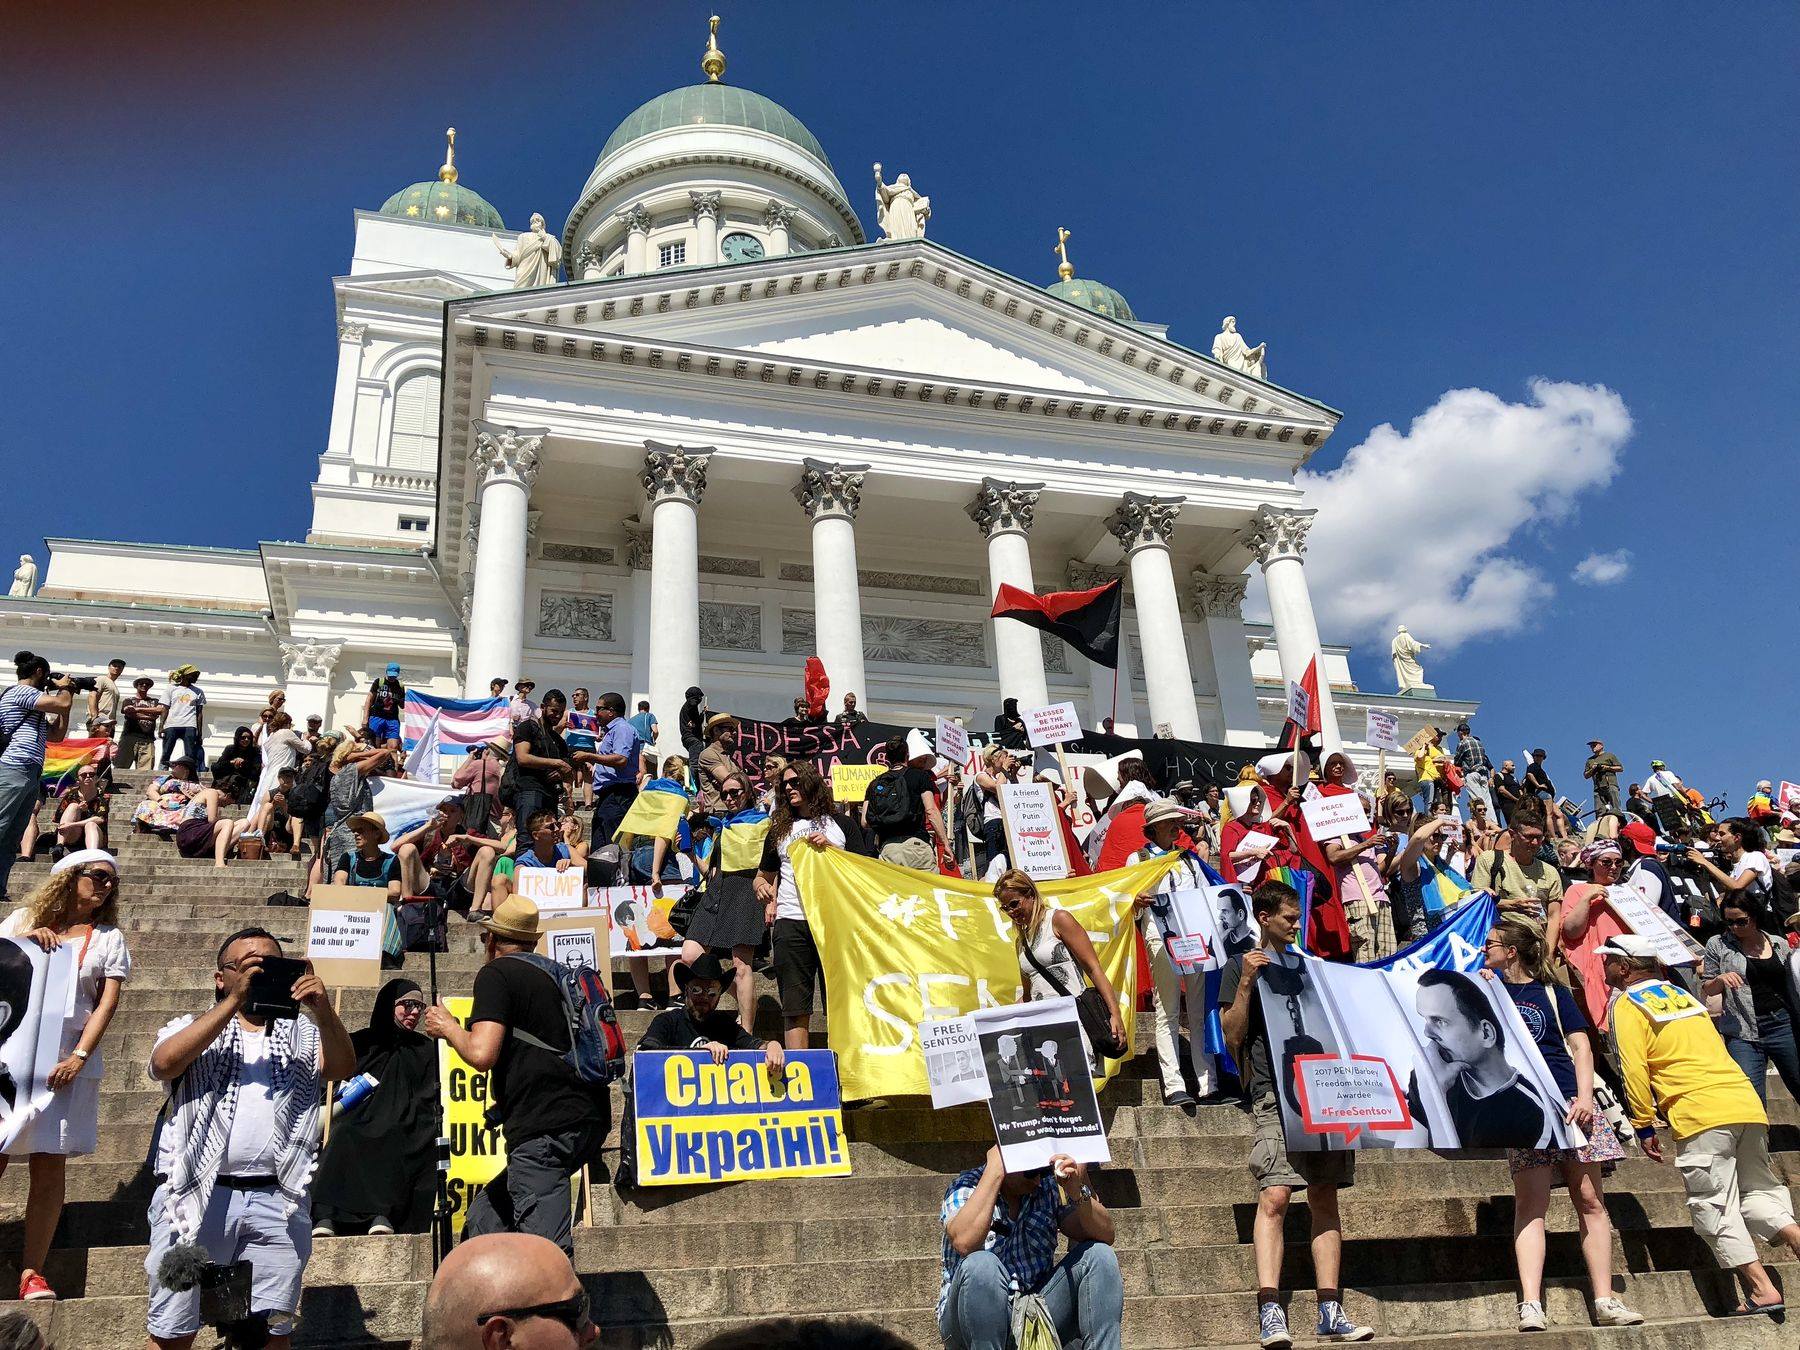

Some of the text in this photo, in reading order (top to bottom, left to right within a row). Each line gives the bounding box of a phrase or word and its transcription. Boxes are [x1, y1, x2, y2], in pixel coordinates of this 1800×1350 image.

[1034, 708, 1065, 719] BLESSED
[1039, 718, 1049, 726] BE
[943, 723, 961, 736] BLESSED
[1033, 722, 1073, 734] IMMIGRANT
[737, 722, 861, 754] HDESSÄ
[1045, 731, 1066, 739] CHILD
[946, 746, 960, 757] CHILD
[1019, 789, 1040, 797] friend
[1021, 802, 1044, 810] Trump
[1320, 802, 1345, 812] PEACE
[1022, 813, 1041, 821] Putin
[1315, 814, 1359, 828] DEMOCRACY
[1027, 850, 1052, 858] Europe
[1032, 864, 1062, 873] America
[522, 874, 581, 897] TRUMP
[343, 914, 371, 924] "Russia
[312, 925, 370, 937] should go away
[311, 937, 359, 948] and shut up"
[556, 936, 591, 947] ACHTUNG
[933, 1023, 963, 1037] FREE
[923, 1032, 977, 1050] SENTSOV!
[1314, 1067, 1379, 1078] 2017 PEN/Barbey
[664, 1054, 814, 1107] Слава
[1315, 1079, 1384, 1088] Freedom to Write
[1336, 1091, 1372, 1099] Awardee
[1321, 1106, 1392, 1118] #FreeSentsov
[999, 1115, 1083, 1131] Mr Trump, don't forget
[1025, 1129, 1036, 1137] to
[1055, 1125, 1072, 1136] your
[1072, 1123, 1099, 1133] hands!
[450, 1122, 508, 1157] Ukr
[645, 1115, 842, 1180] Україні!
